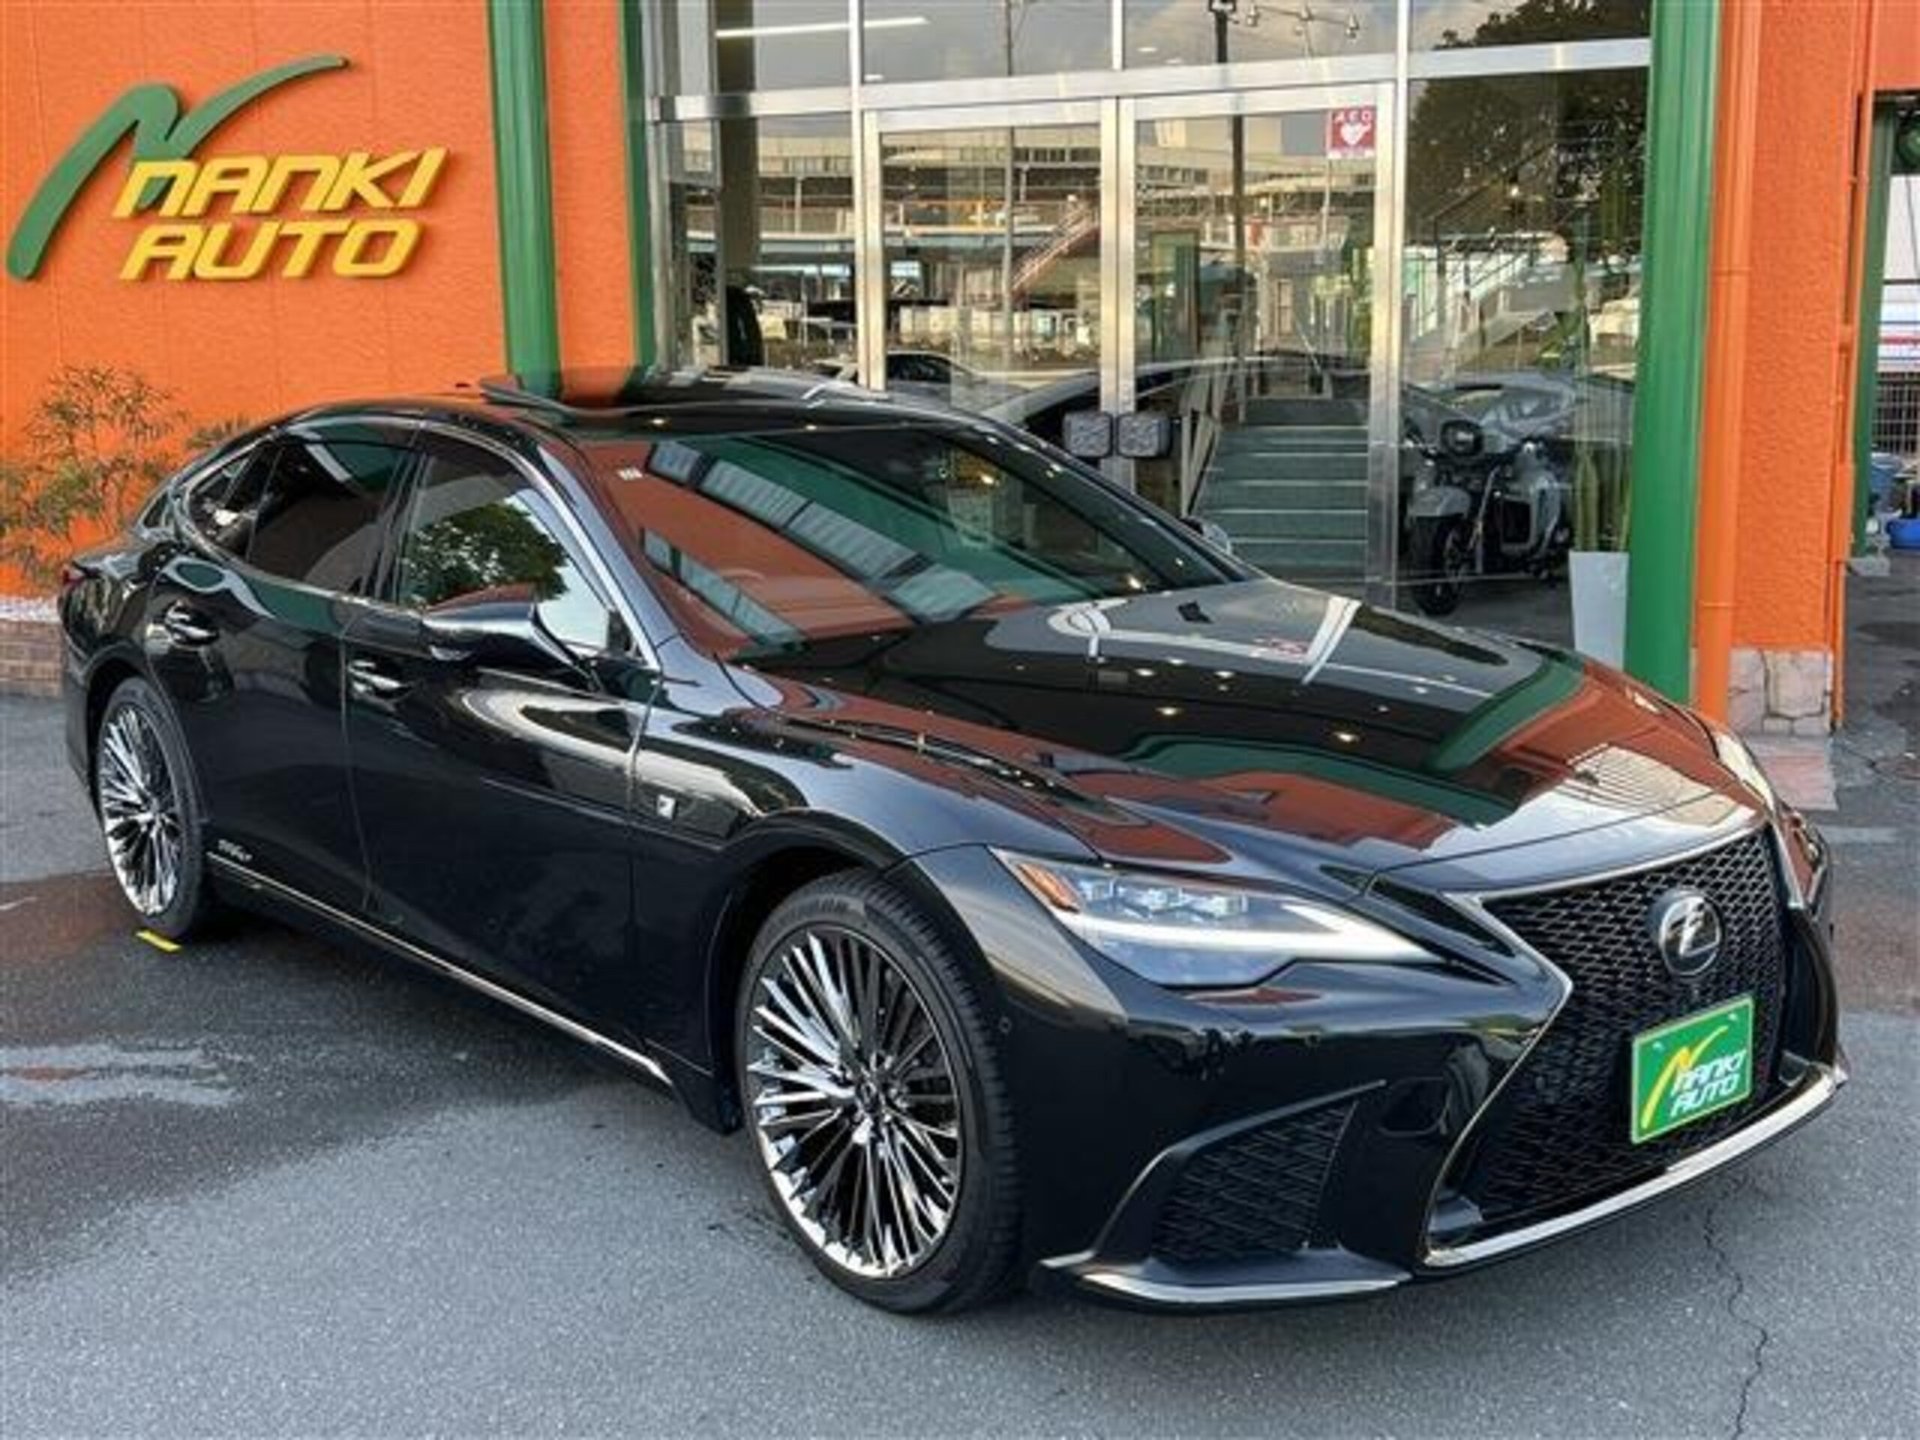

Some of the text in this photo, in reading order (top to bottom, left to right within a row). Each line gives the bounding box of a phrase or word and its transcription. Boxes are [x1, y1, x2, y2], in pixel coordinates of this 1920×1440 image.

[112, 148, 447, 217] NANKI
[119, 219, 420, 280] AUTO
[1670, 1049, 1747, 1097] NANKI
[1670, 1073, 1740, 1117] AUTO
